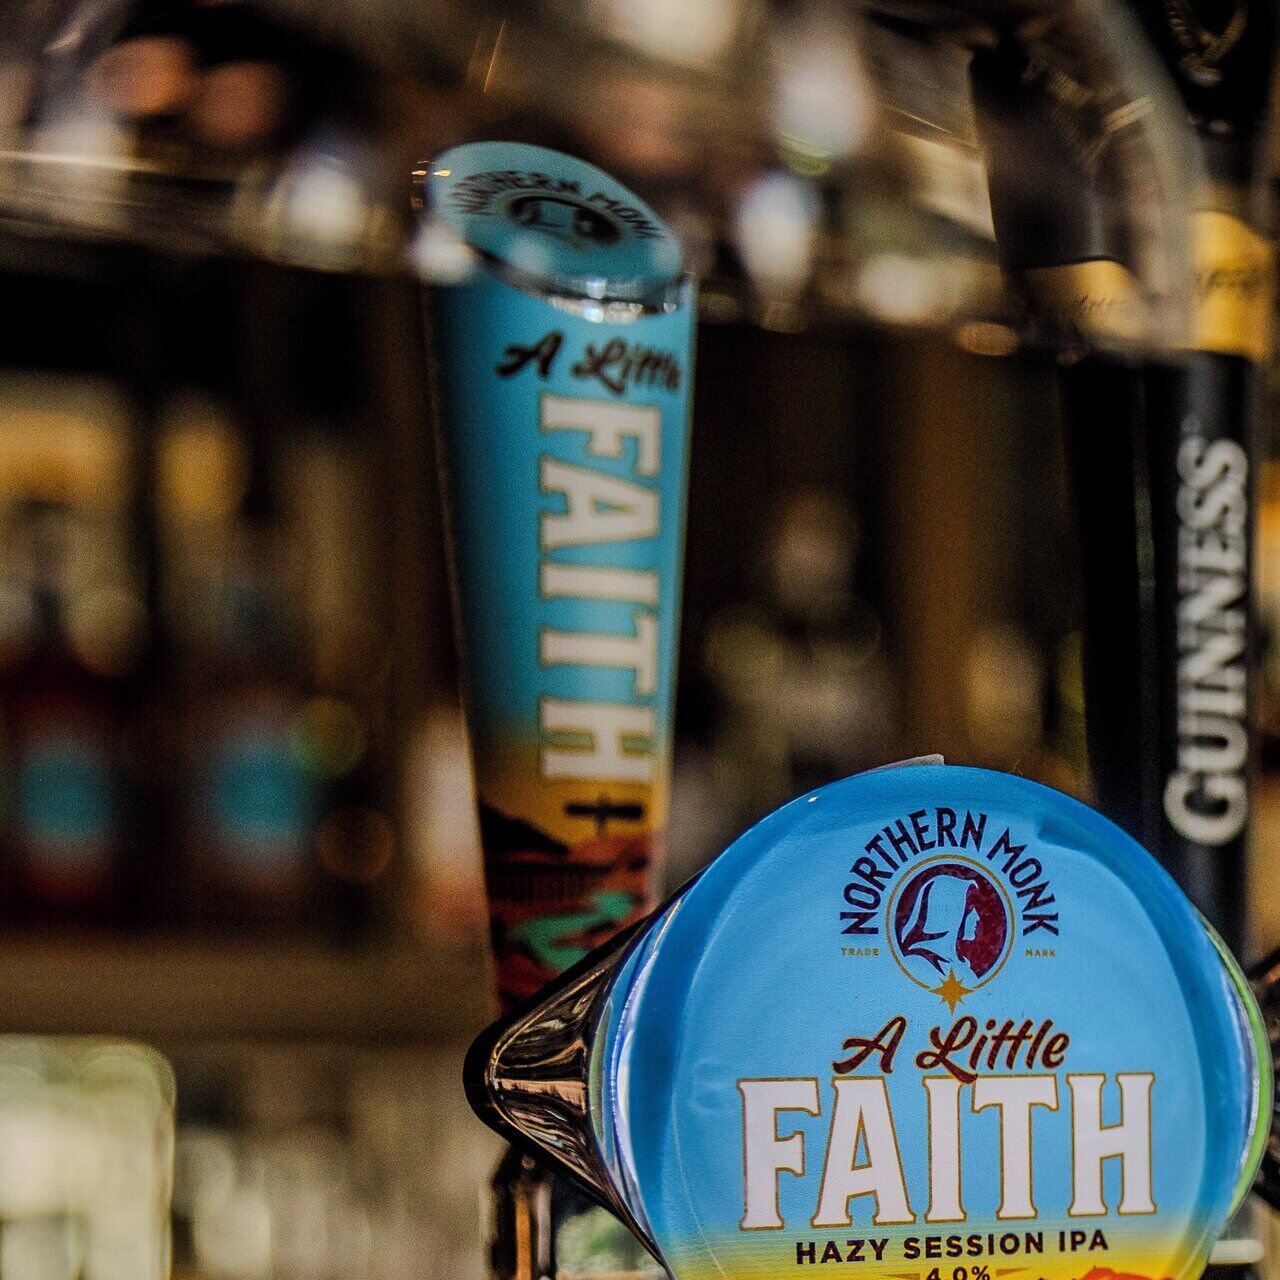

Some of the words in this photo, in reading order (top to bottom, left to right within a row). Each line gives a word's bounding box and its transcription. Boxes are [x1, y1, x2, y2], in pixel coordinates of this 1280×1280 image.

[496, 331, 564, 379] A
[538, 393, 661, 784] FAITH
[1163, 436, 1249, 846] GUINNESS
[839, 807, 987, 935] NORTHERN
[986, 827, 1059, 936] MONK
[841, 947, 879, 957] TRADE
[1026, 948, 1056, 957] MARK
[832, 1015, 906, 1075] A
[915, 1015, 1070, 1085] Little
[736, 1072, 1157, 1231] FAITH
[796, 1238, 889, 1265] HAZY
[903, 1232, 1044, 1260] SESSION
[1059, 1229, 1109, 1252] IPA
